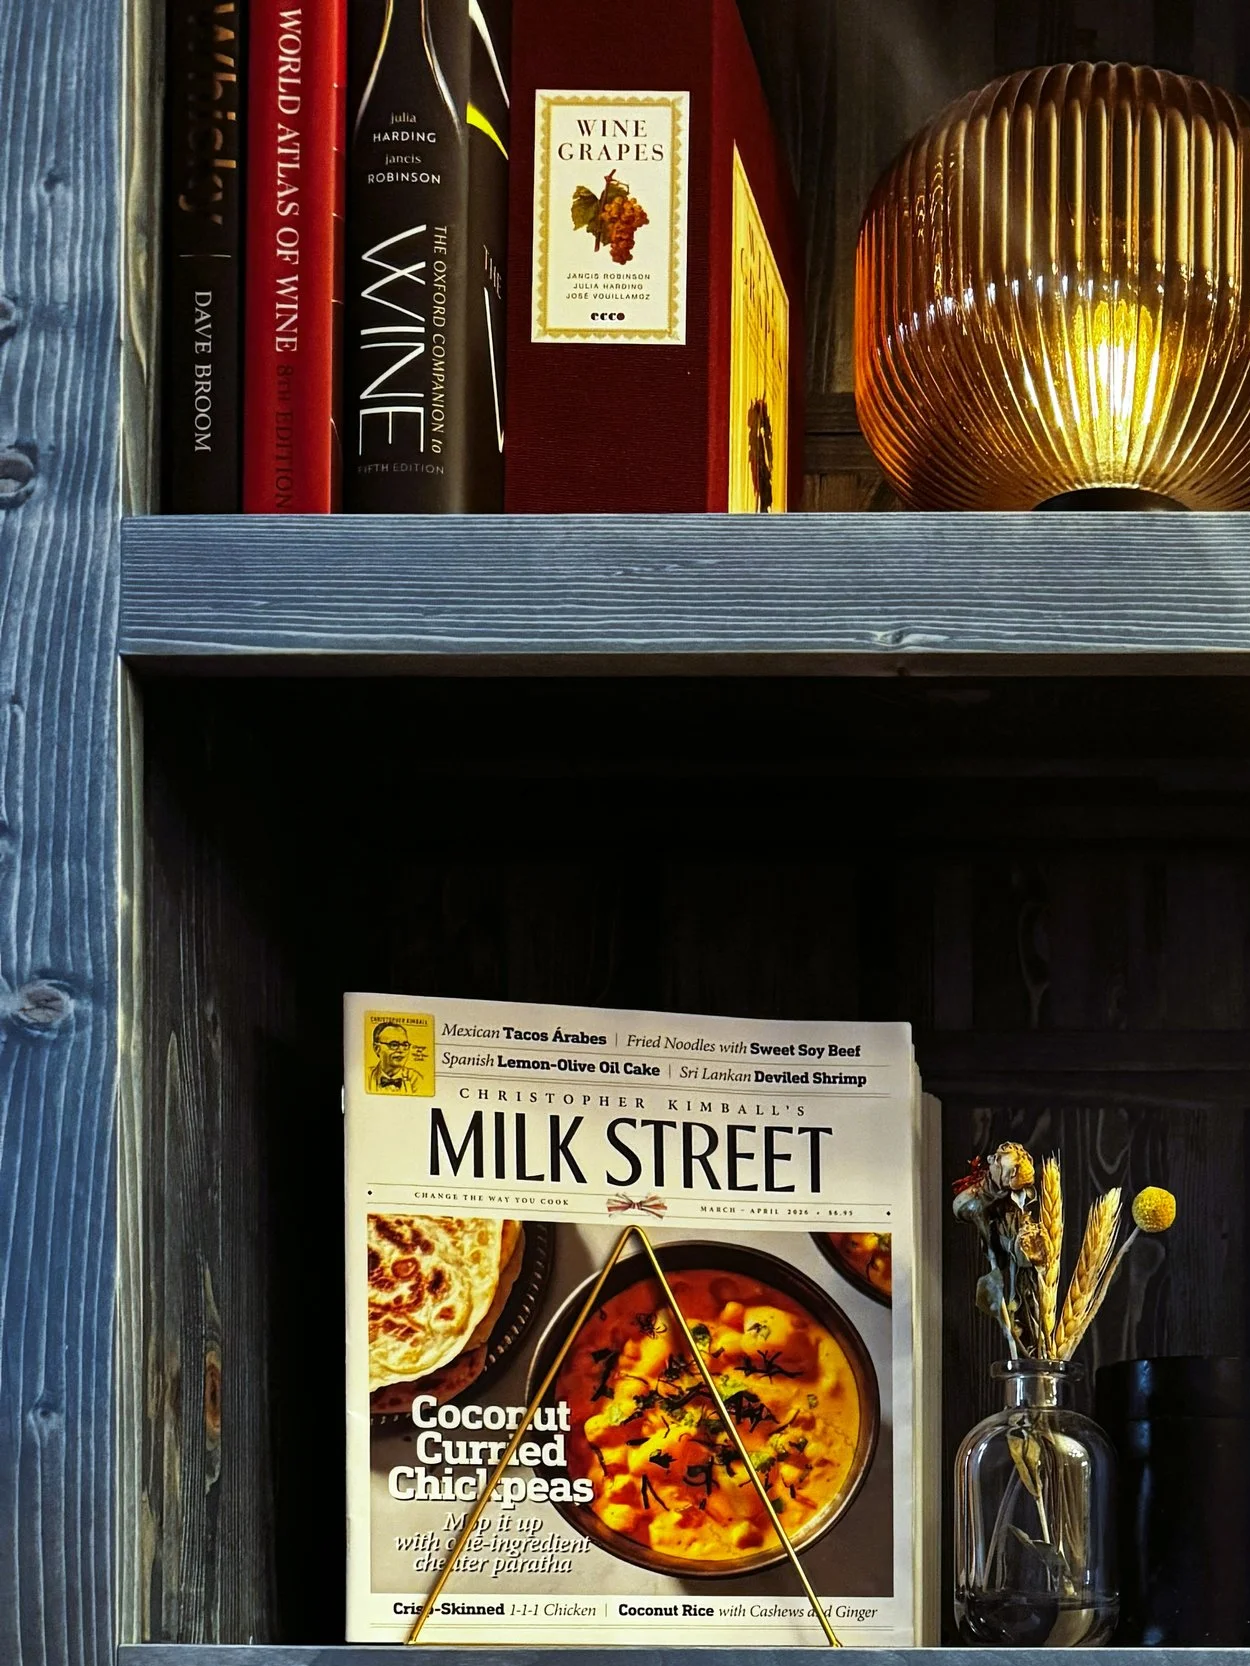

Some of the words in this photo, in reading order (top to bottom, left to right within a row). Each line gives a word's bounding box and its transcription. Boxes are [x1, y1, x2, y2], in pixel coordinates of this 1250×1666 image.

[277, 8, 302, 114] WORLD
[390, 112, 417, 124] julia
[577, 119, 648, 138] WINE
[373, 131, 436, 143] HARDING
[557, 143, 665, 162] GRAPES
[278, 122, 301, 218] ATLAS
[385, 153, 421, 165] jancis
[368, 173, 441, 184] ROBINSON
[277, 224, 300, 269] OF
[434, 225, 446, 255] THE
[433, 260, 446, 327] OXFORD
[567, 272, 599, 280] JANCIS
[195, 291, 211, 354] DAVE
[276, 275, 298, 353] WINE
[590, 312, 625, 321] ecco
[359, 224, 427, 455] WINE
[431, 334, 446, 432] COMPANION
[195, 364, 211, 452] BROOM
[441, 1023, 500, 1039] Mexican
[503, 1027, 549, 1042] Tacos
[552, 1024, 607, 1045] Árabes
[627, 1033, 661, 1048] Fried
[663, 1035, 717, 1053] Noodles
[720, 1040, 748, 1054] with
[750, 1042, 795, 1057] Sweet
[798, 1043, 826, 1061] Soy
[828, 1044, 861, 1058] Beef
[441, 1052, 495, 1070] Spanish
[497, 1056, 596, 1074] Lemon-Olive
[599, 1060, 618, 1074] Oil
[621, 1061, 660, 1077] Cake
[679, 1065, 697, 1079] Sri
[700, 1066, 751, 1082] Lankan
[754, 1070, 809, 1085] Deviled
[812, 1071, 867, 1088] Shrimp
[459, 1087, 646, 1109] CHRISTOPHER
[668, 1099, 806, 1116] KIMBALL'S
[428, 1108, 589, 1183] MILK
[604, 1117, 833, 1193] STREET
